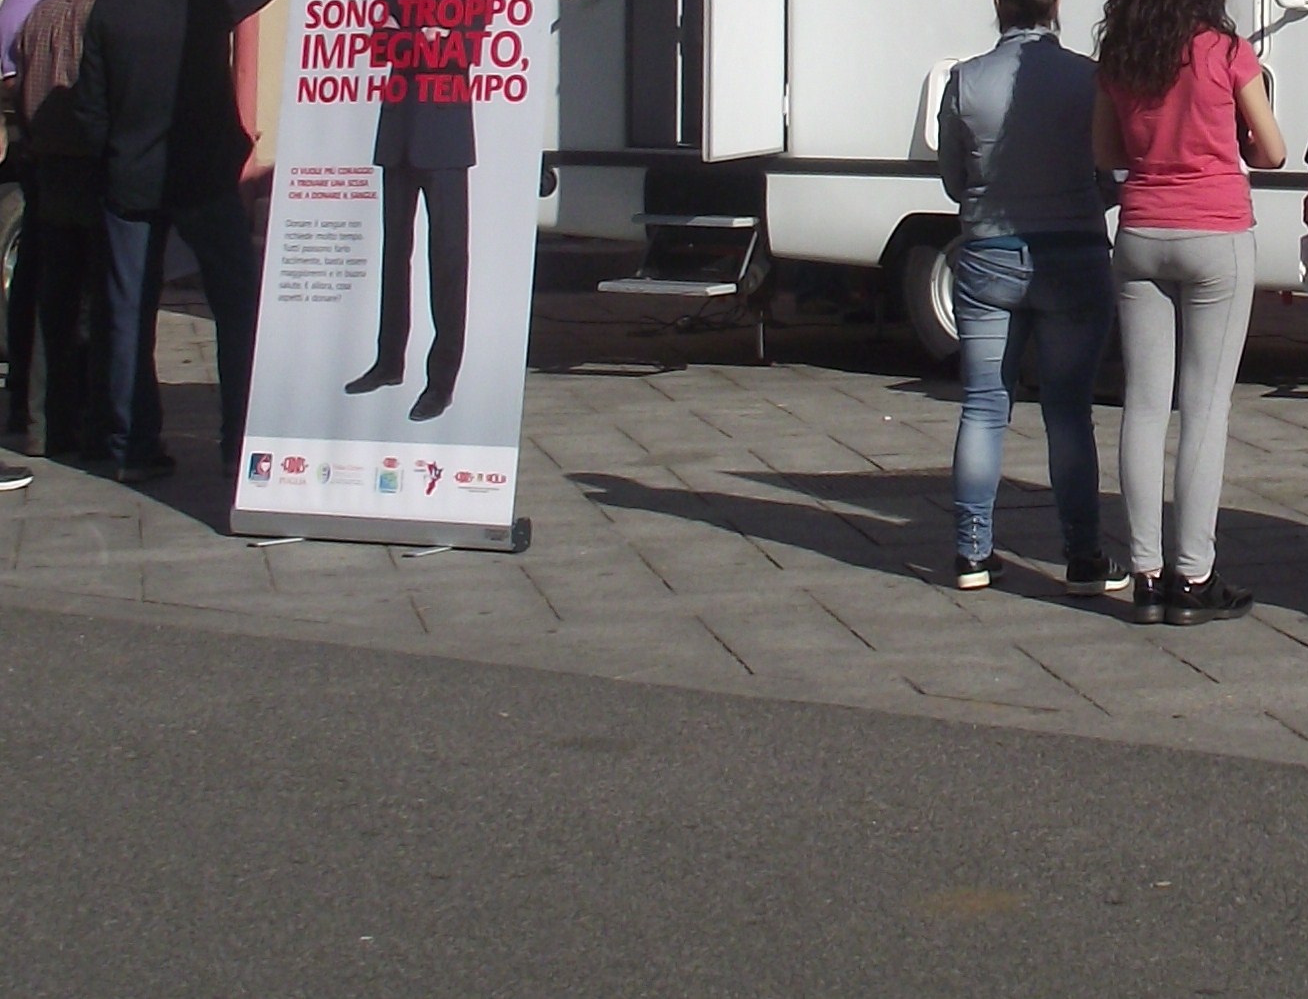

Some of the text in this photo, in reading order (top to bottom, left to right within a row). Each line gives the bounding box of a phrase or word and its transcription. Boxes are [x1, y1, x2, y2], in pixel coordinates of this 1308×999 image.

[301, 31, 529, 71] IMPEGNATO,
[298, 74, 528, 103] NON HO TEMPO
